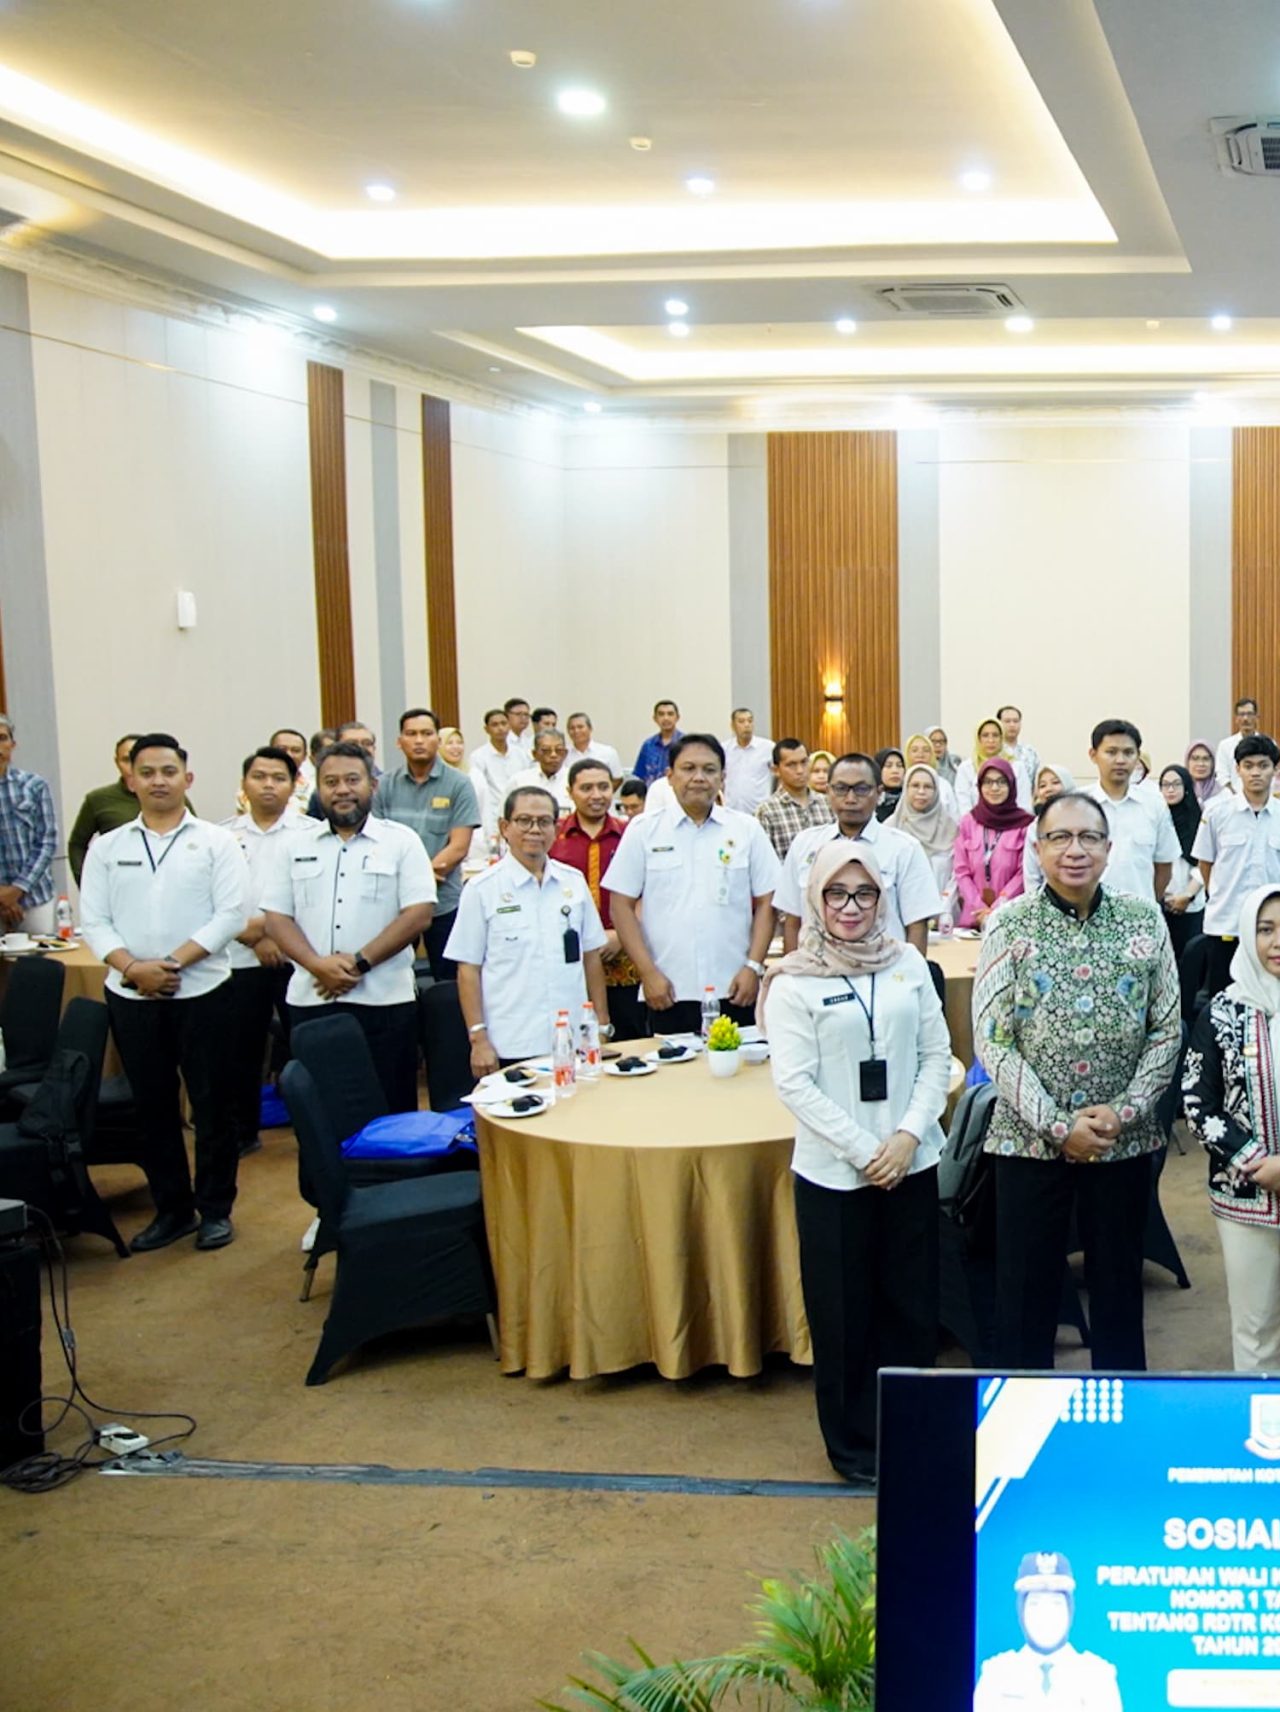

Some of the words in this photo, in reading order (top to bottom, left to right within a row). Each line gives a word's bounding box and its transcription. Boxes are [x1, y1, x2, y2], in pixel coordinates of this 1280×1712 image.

[1097, 1566, 1215, 1586] PERATURAN
[1218, 1567, 1268, 1587] WALI
[1170, 1590, 1244, 1609] NOMOR
[1249, 1591, 1258, 1609] 1
[1108, 1612, 1199, 1632] TENTANG
[1193, 1636, 1259, 1655] TAHUN
